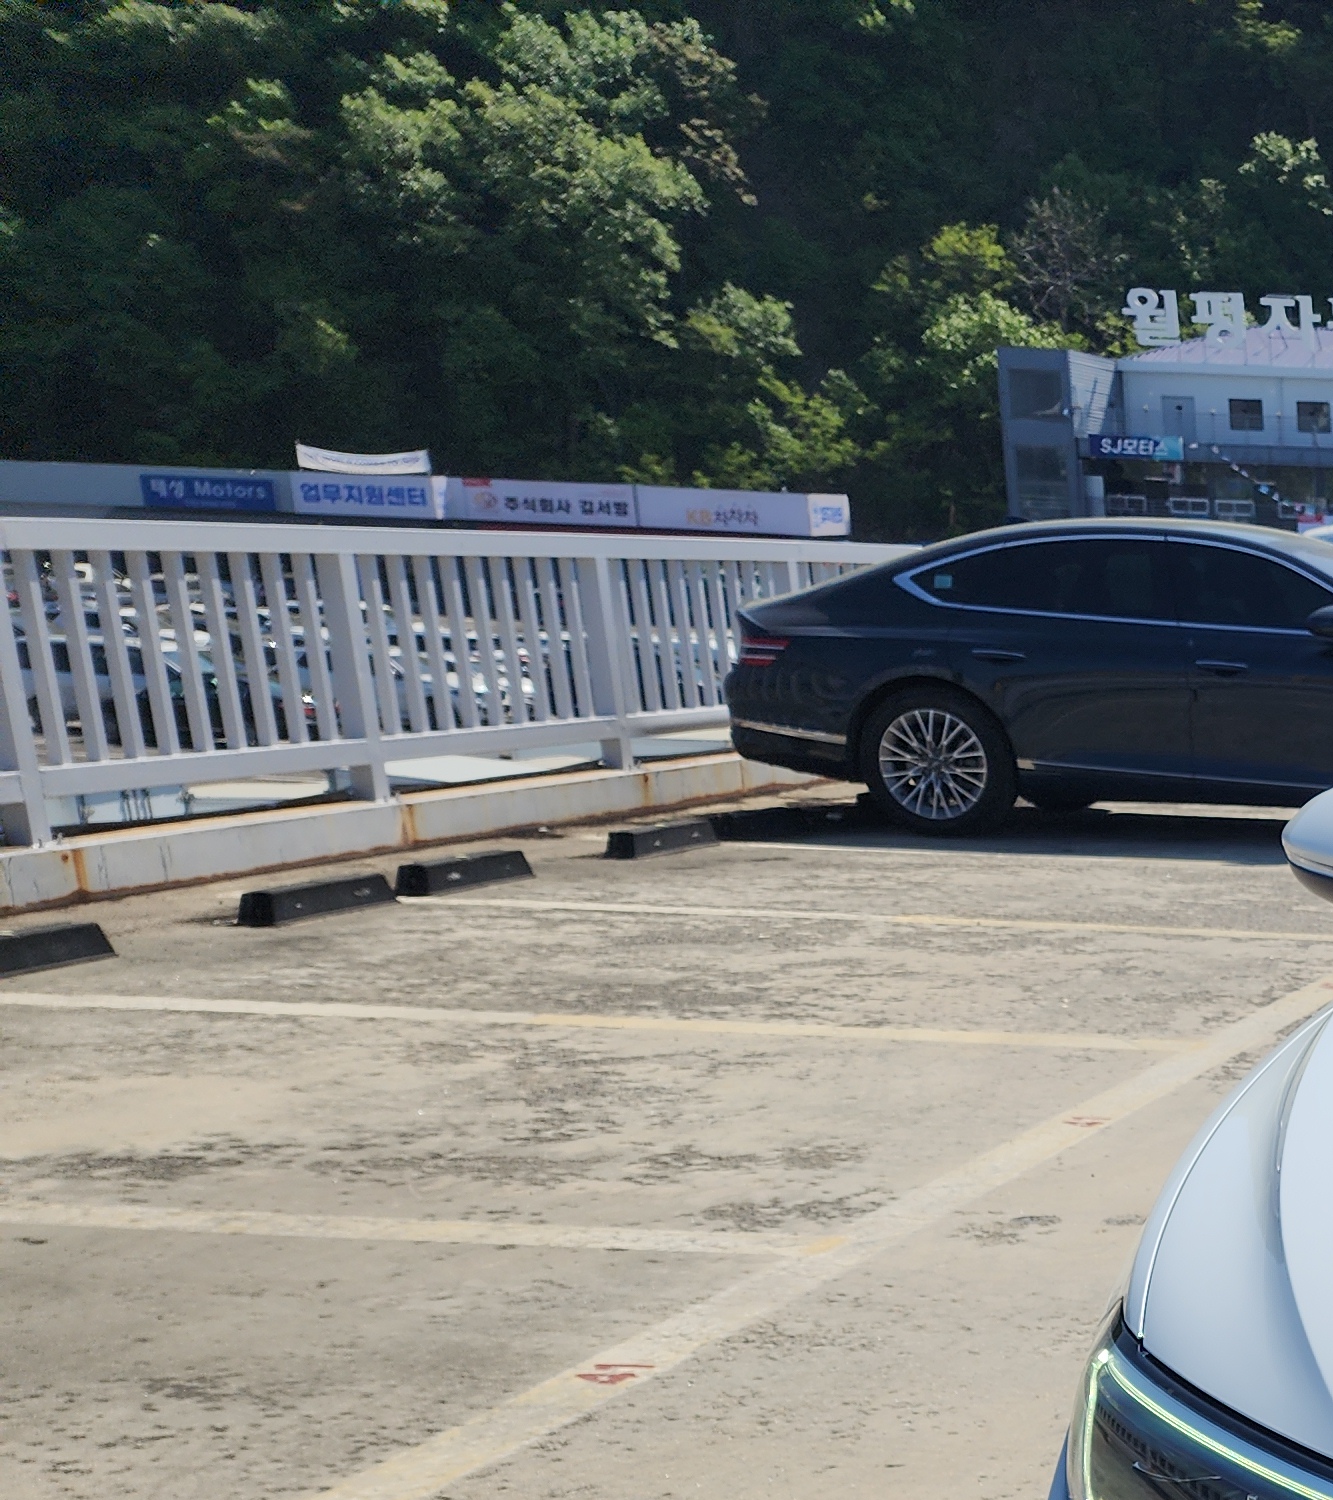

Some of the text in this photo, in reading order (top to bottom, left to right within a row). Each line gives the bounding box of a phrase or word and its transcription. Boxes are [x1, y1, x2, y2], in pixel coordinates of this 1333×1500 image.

[193, 481, 265, 500] Motors
[300, 482, 427, 506] 업무지원센터
[505, 496, 571, 514] 주식회사
